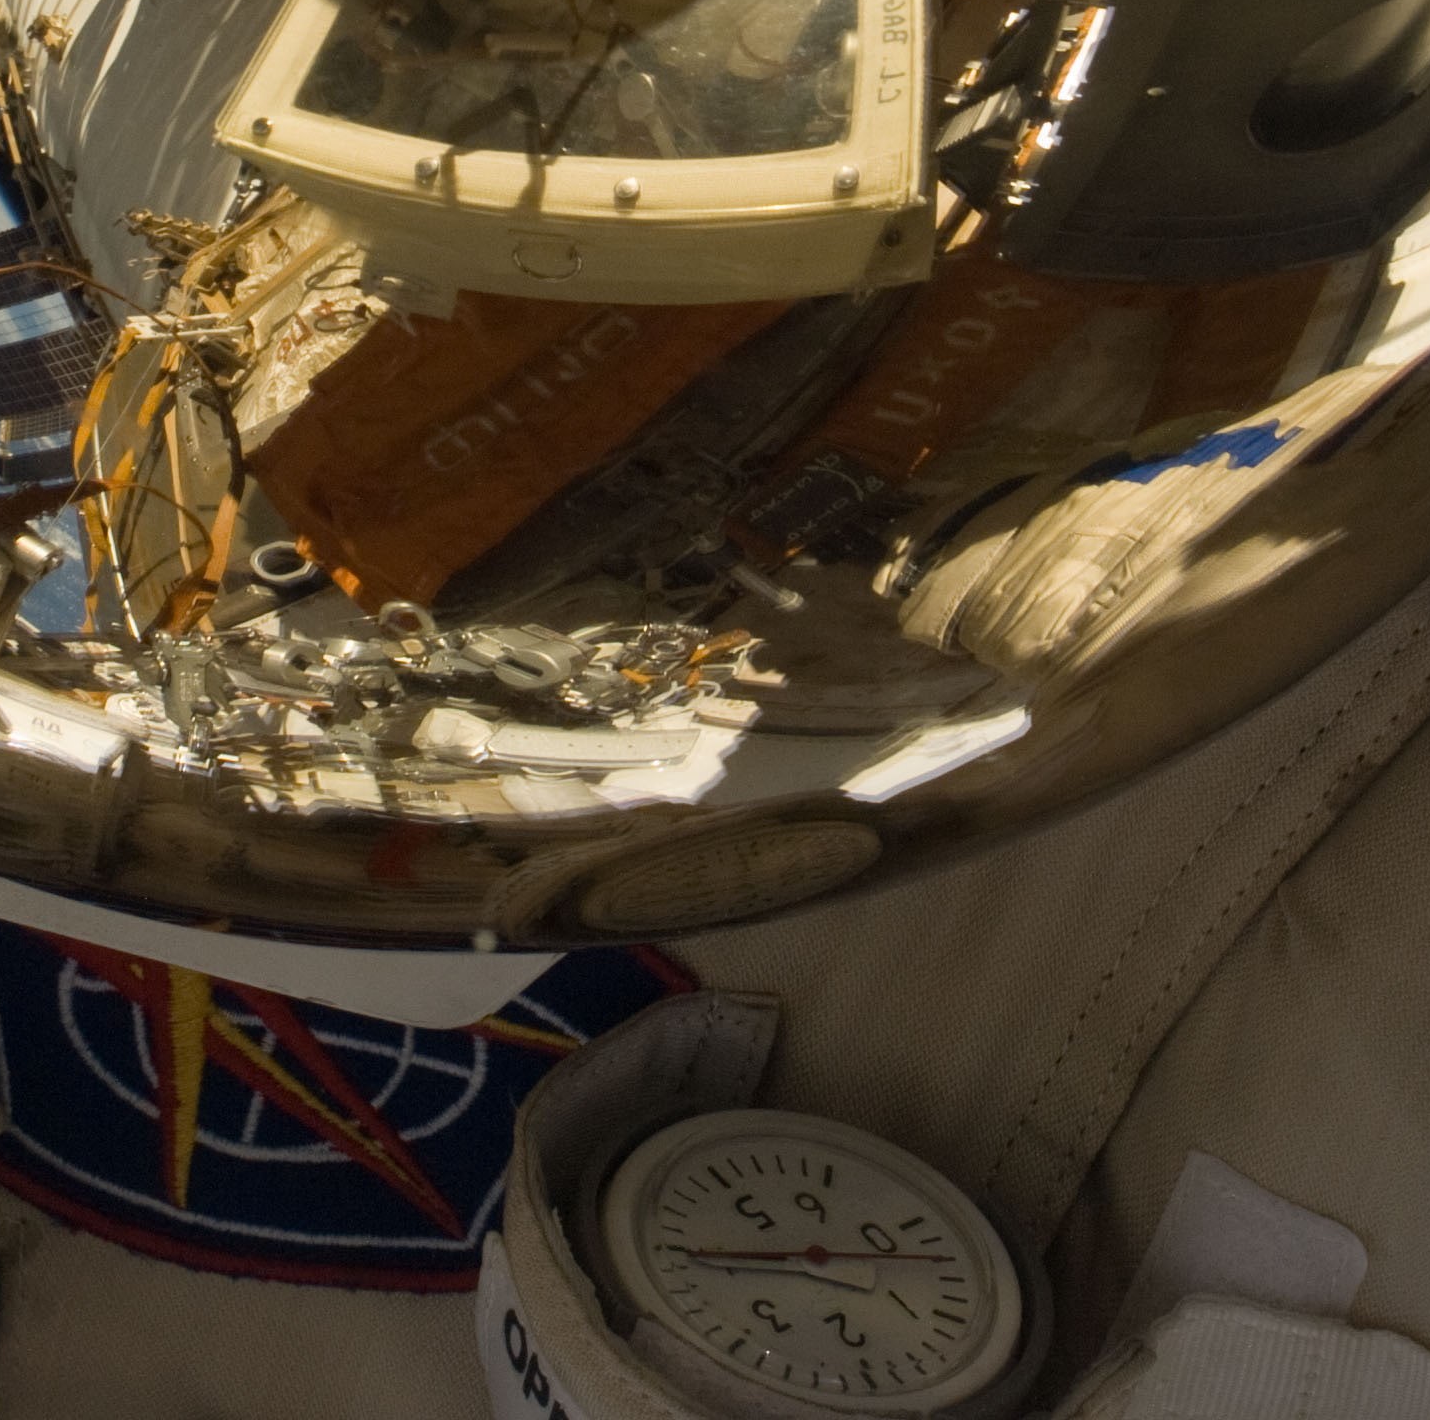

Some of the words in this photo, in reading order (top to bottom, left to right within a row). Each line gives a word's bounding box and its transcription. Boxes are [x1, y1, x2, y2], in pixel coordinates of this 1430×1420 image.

[734, 1192, 777, 1231] 5
[859, 1221, 898, 1254] 0
[751, 1298, 792, 1333] 3
[823, 1312, 866, 1349] 2
[504, 1308, 568, 1420] ОР
